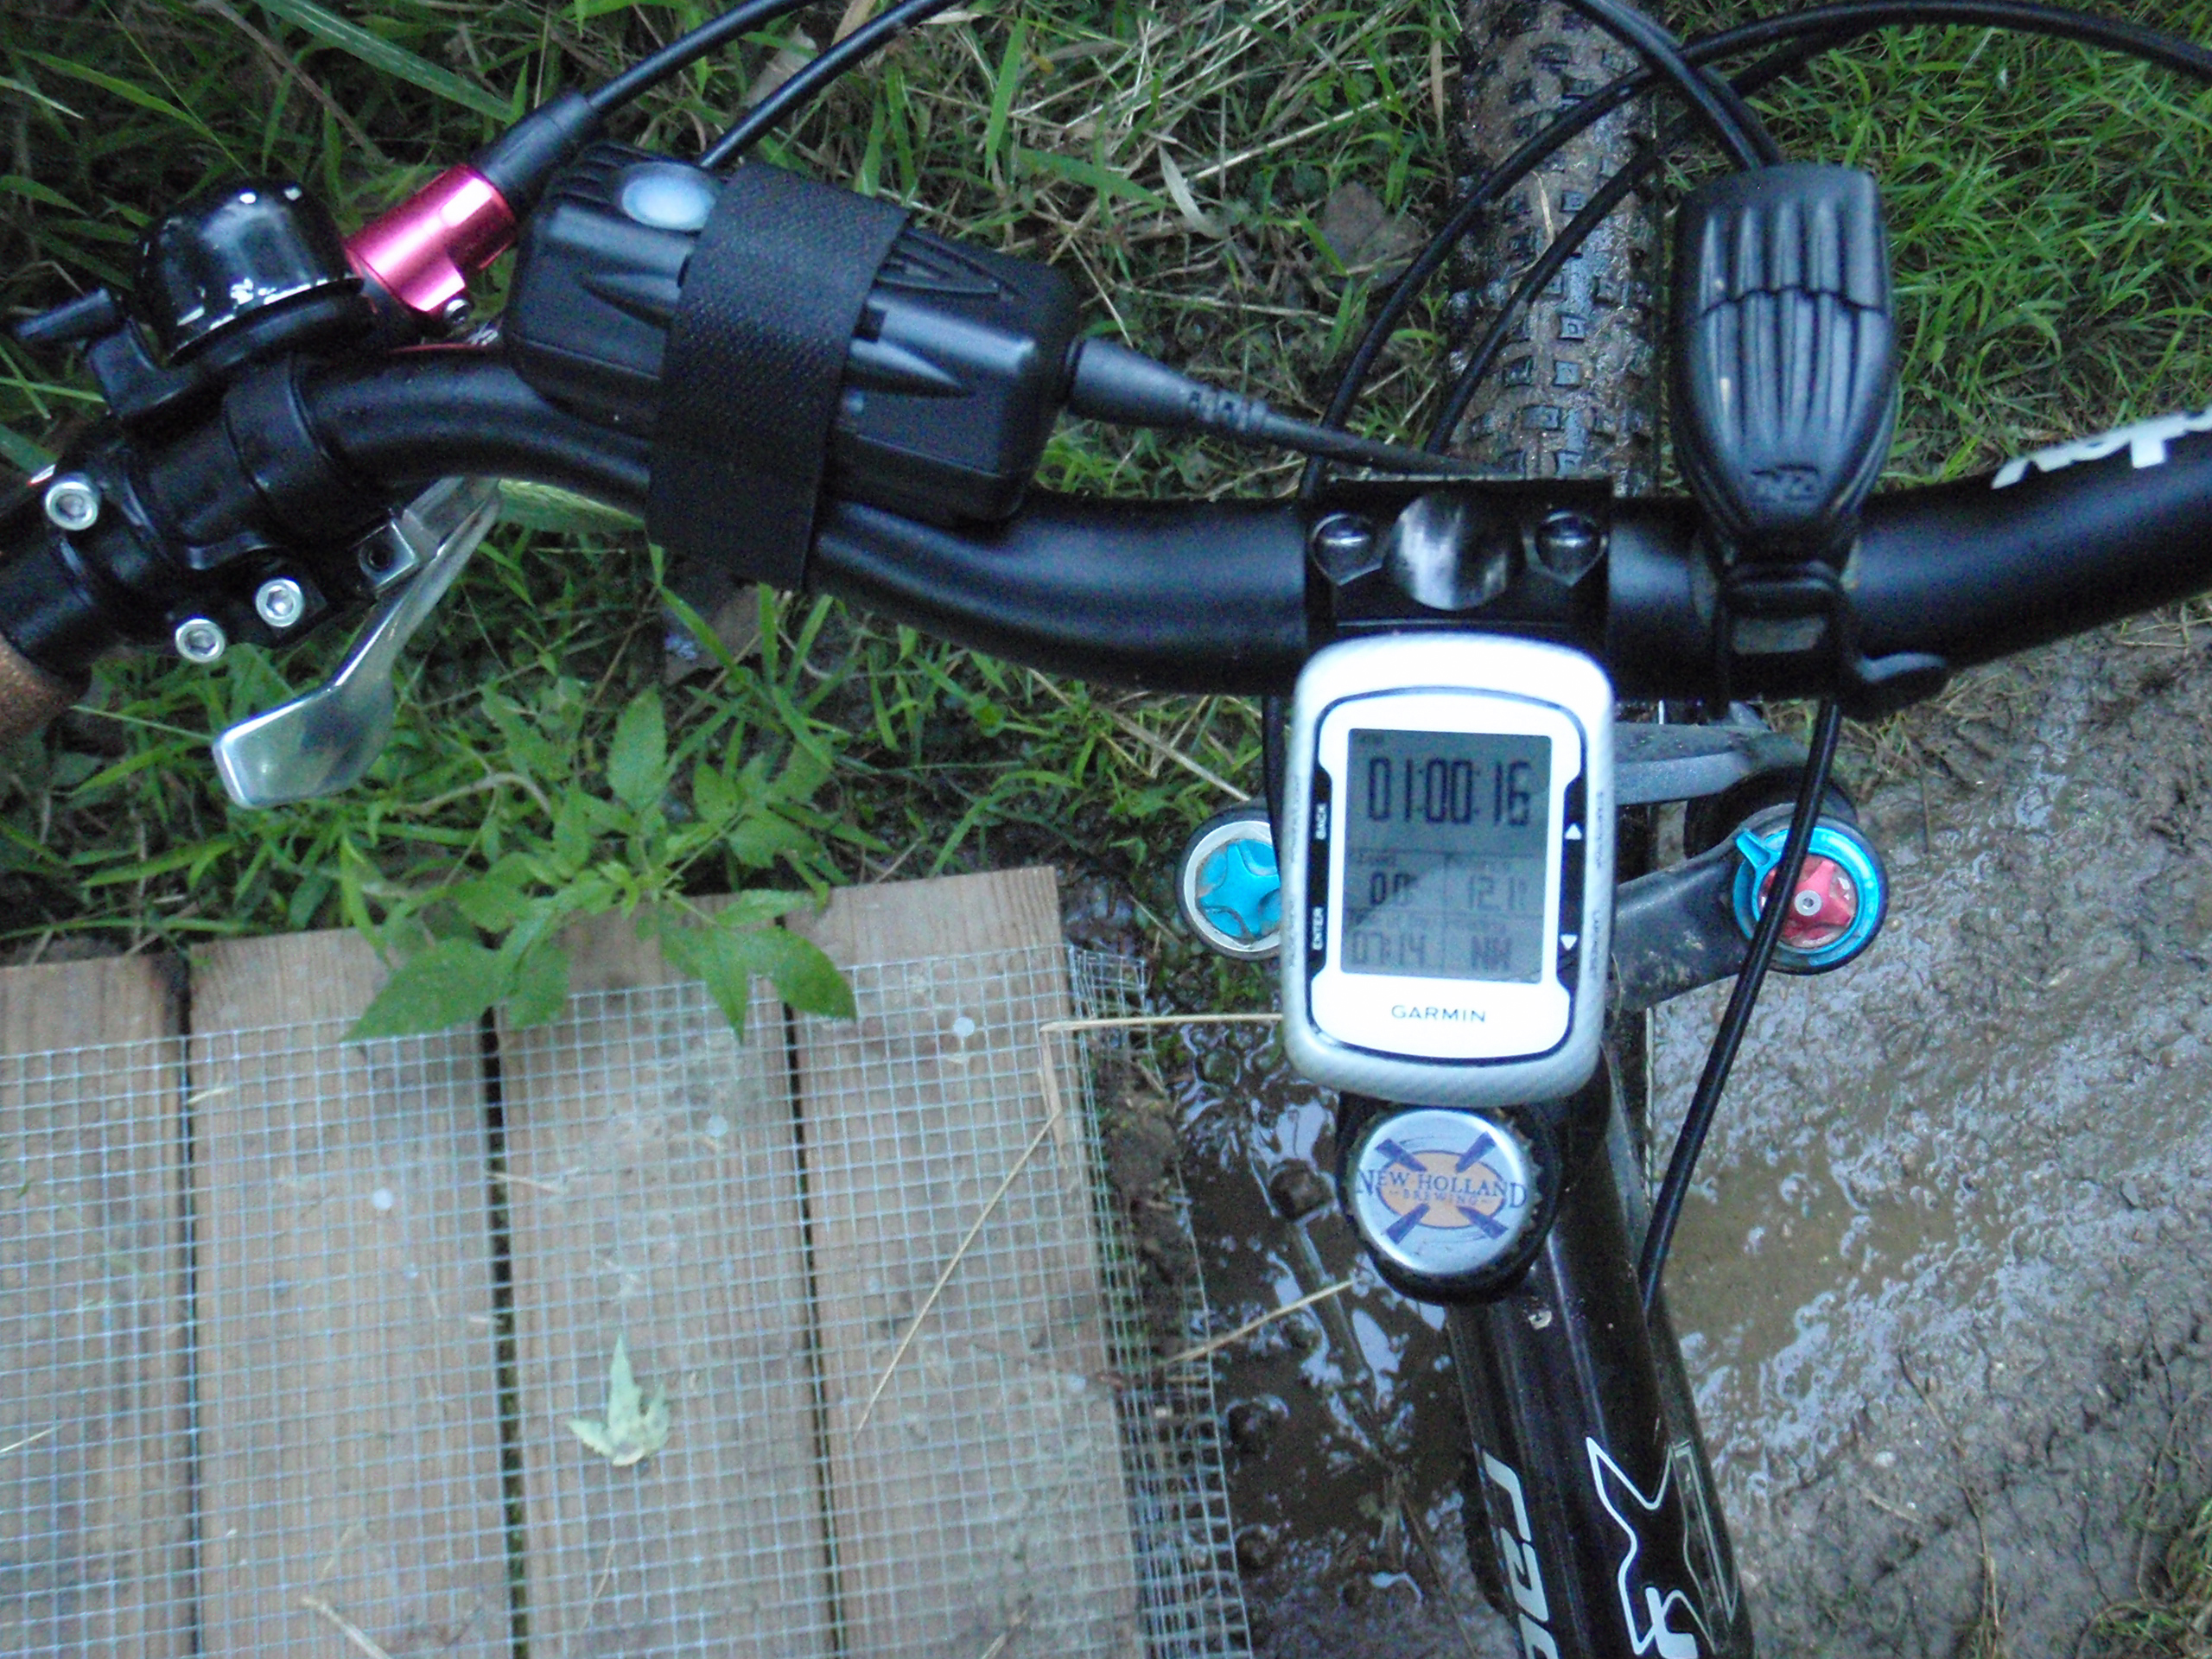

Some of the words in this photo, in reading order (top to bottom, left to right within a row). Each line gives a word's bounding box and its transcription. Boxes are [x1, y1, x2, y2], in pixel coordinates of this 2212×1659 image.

[1316, 803, 1327, 840] BACK
[1312, 906, 1324, 950] ENTER
[1391, 1004, 1485, 1022] GARMIN
[1357, 1168, 1410, 1196] NEW
[1418, 1174, 1528, 1208] HOLLAND
[1403, 1191, 1478, 1206] BREWING
